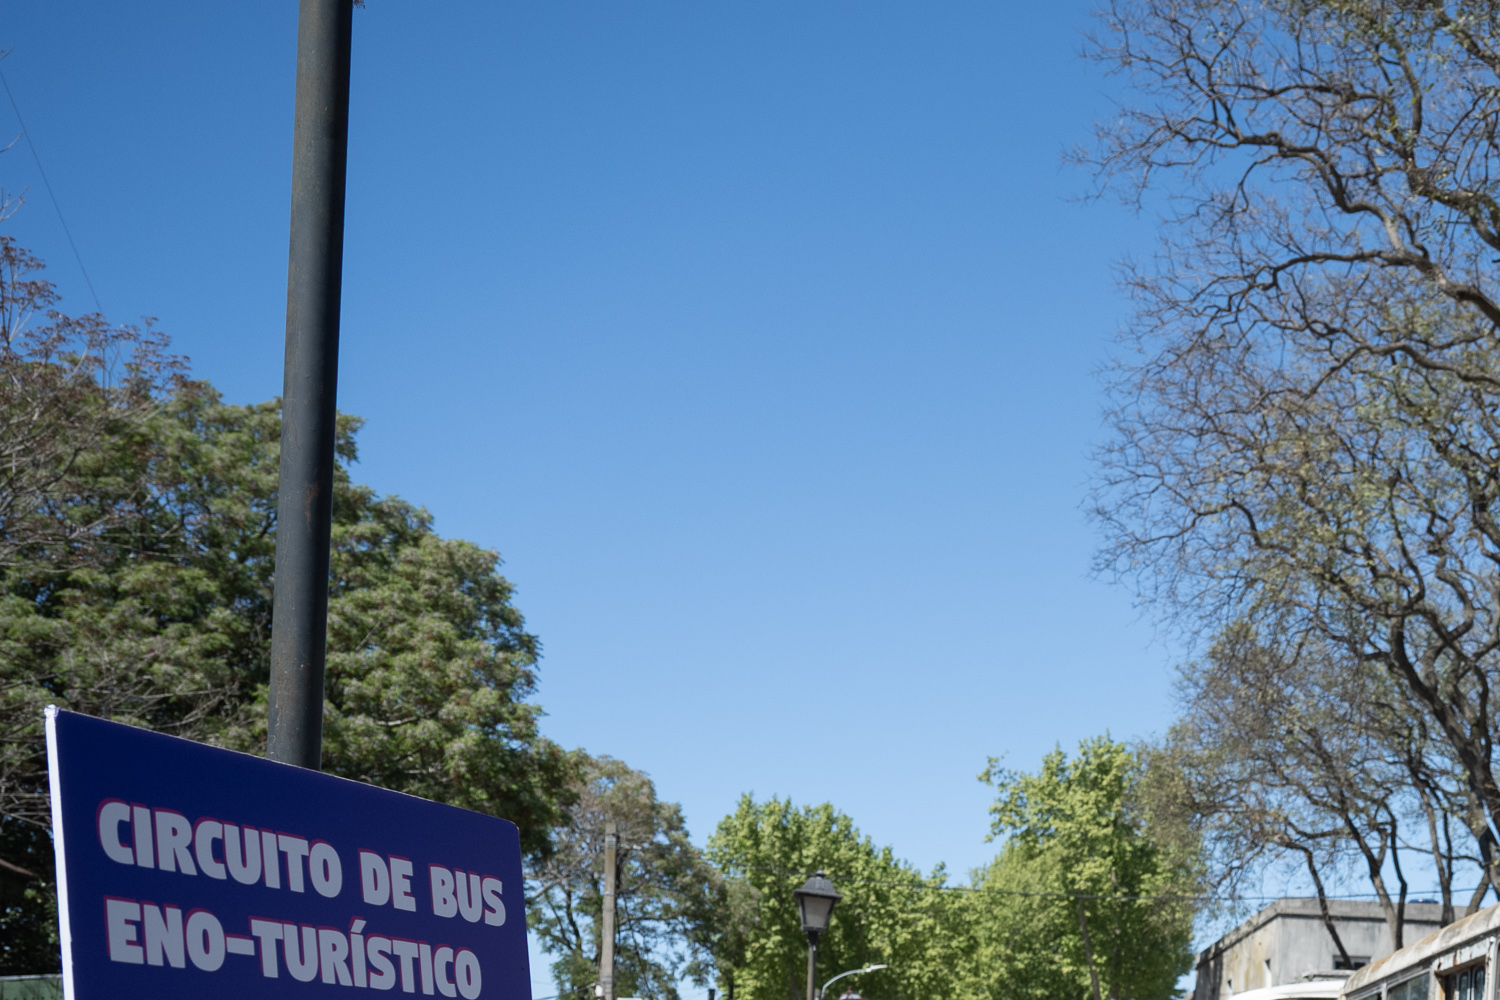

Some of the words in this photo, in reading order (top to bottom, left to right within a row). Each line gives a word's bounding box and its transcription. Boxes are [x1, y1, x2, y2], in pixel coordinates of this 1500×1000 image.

[98, 799, 342, 898] CIRCUITO
[359, 850, 416, 912] DE
[429, 864, 506, 926] BUS
[105, 894, 482, 1000] ENO-TURÍSTICO
